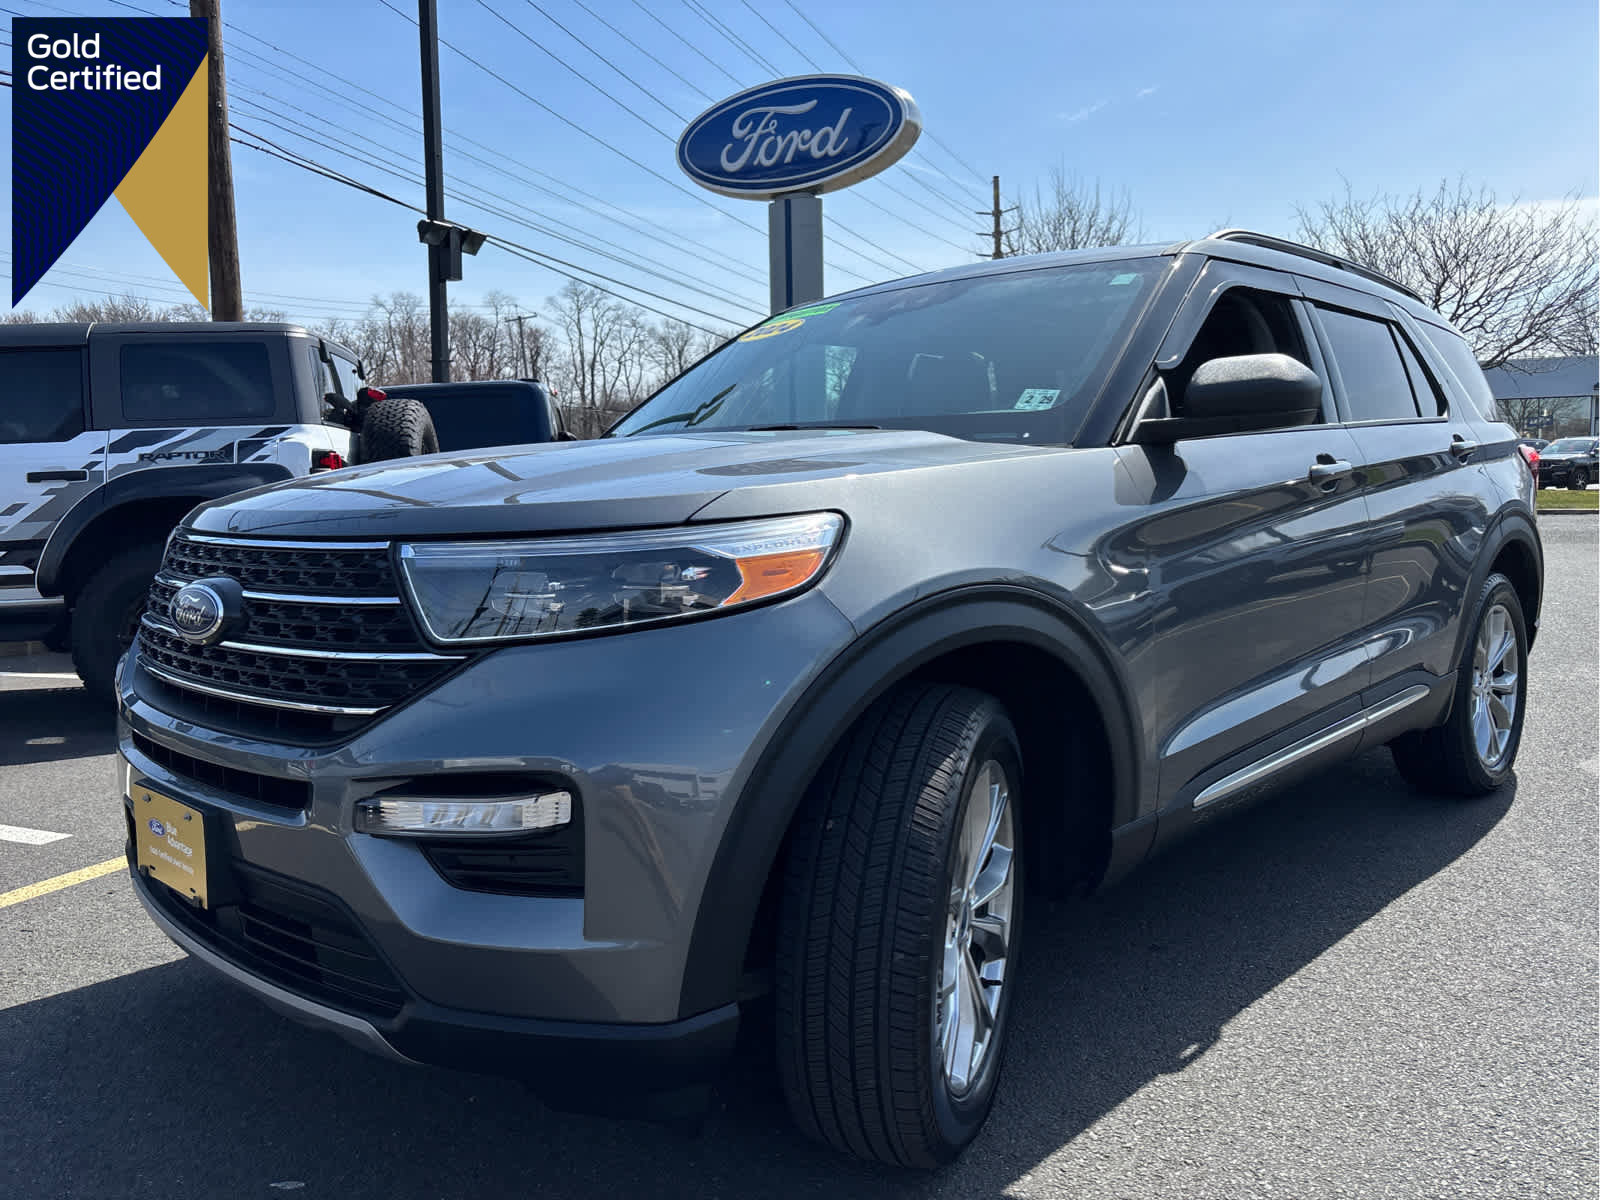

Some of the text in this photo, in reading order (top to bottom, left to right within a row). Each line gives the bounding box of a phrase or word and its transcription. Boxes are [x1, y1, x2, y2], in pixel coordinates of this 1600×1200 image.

[720, 99, 854, 173] Ford
[138, 450, 226, 465] RAPTOR
[732, 537, 817, 553] EXPLORER
[175, 593, 206, 627] Ford
